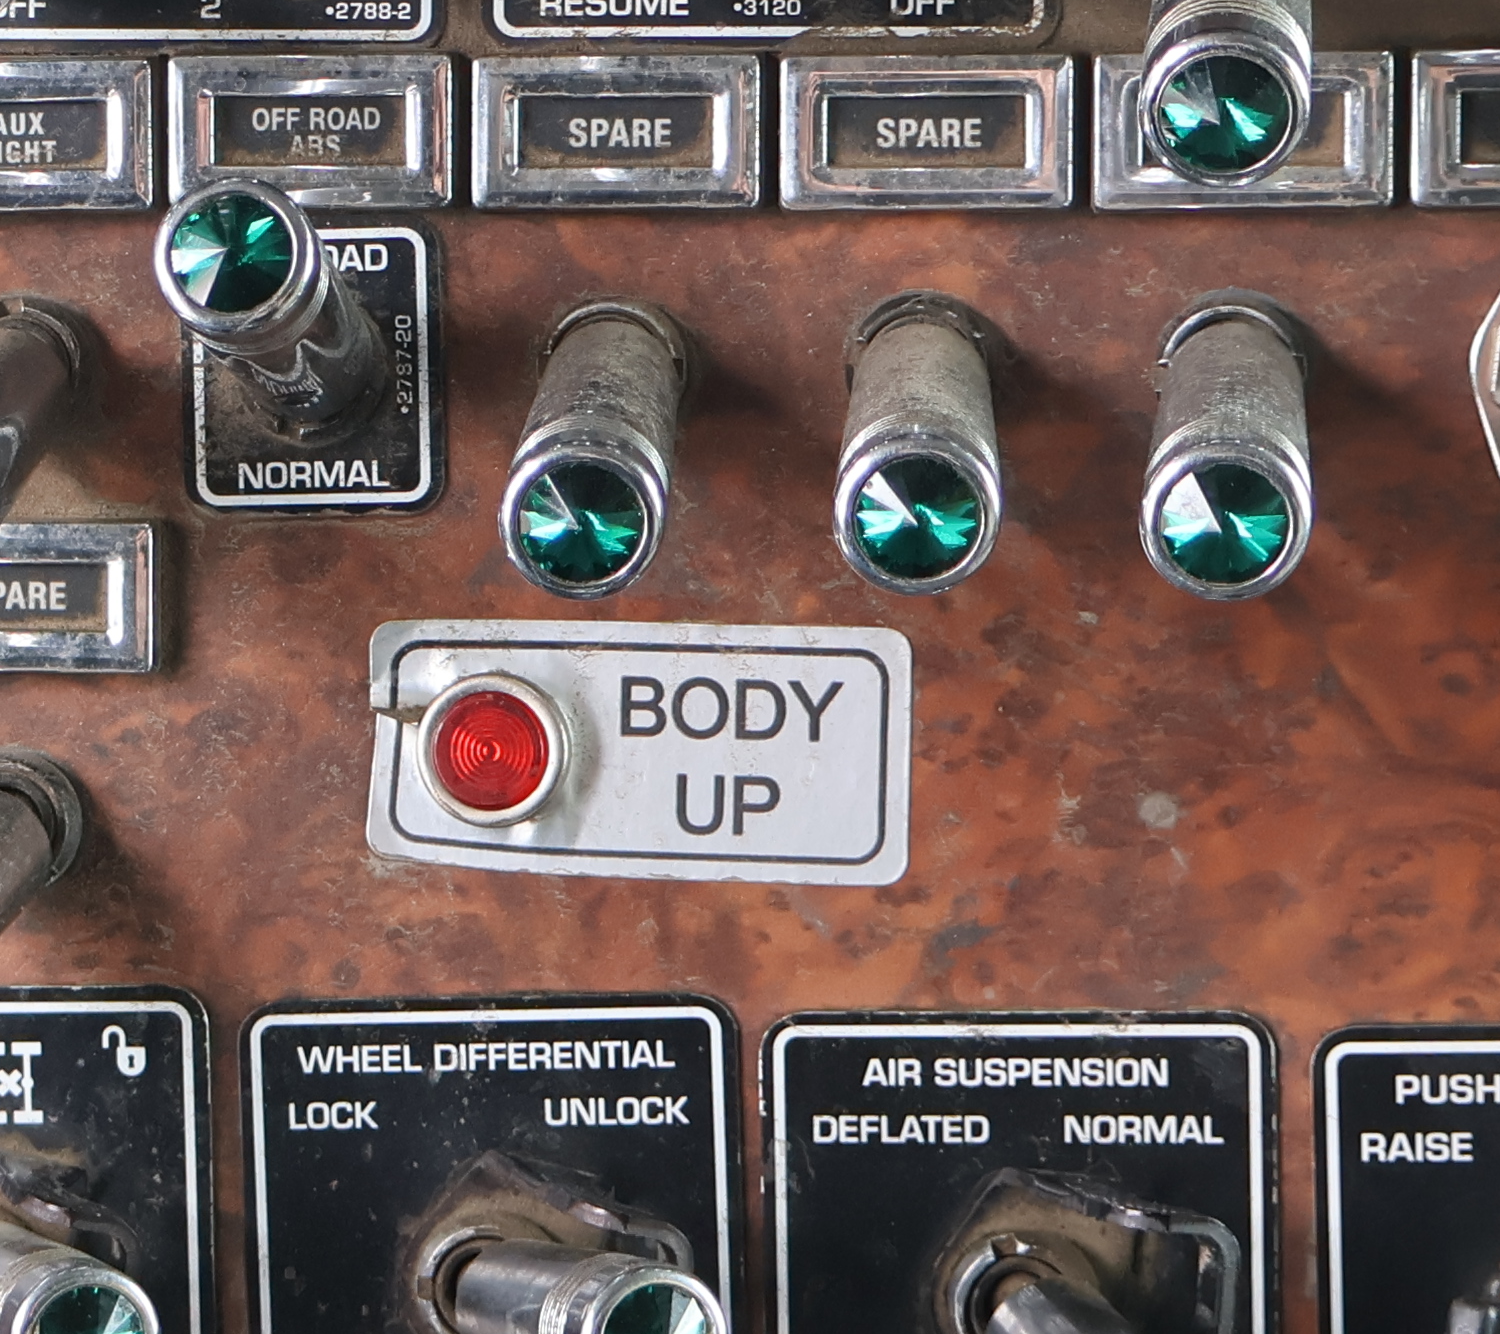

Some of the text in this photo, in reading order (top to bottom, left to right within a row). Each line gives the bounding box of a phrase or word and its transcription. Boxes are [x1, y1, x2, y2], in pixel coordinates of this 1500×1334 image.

[251, 107, 381, 133] OFF ROAD
[568, 117, 672, 149] SPARE
[875, 117, 982, 149] SPARE
[289, 134, 342, 158] ABS
[237, 461, 391, 490] NORMAL
[620, 674, 844, 744] BODY
[676, 773, 781, 836] UP
[297, 1038, 675, 1074] WHEEL DIFFERENTIAL
[861, 1057, 1169, 1088] AIR SUSPENSION
[286, 1100, 378, 1131] LOCK
[543, 1095, 689, 1128] UNLOCK
[811, 1114, 990, 1147] DEFLATED
[1063, 1114, 1224, 1146] NORMAL
[1359, 1131, 1474, 1164] RAISE
